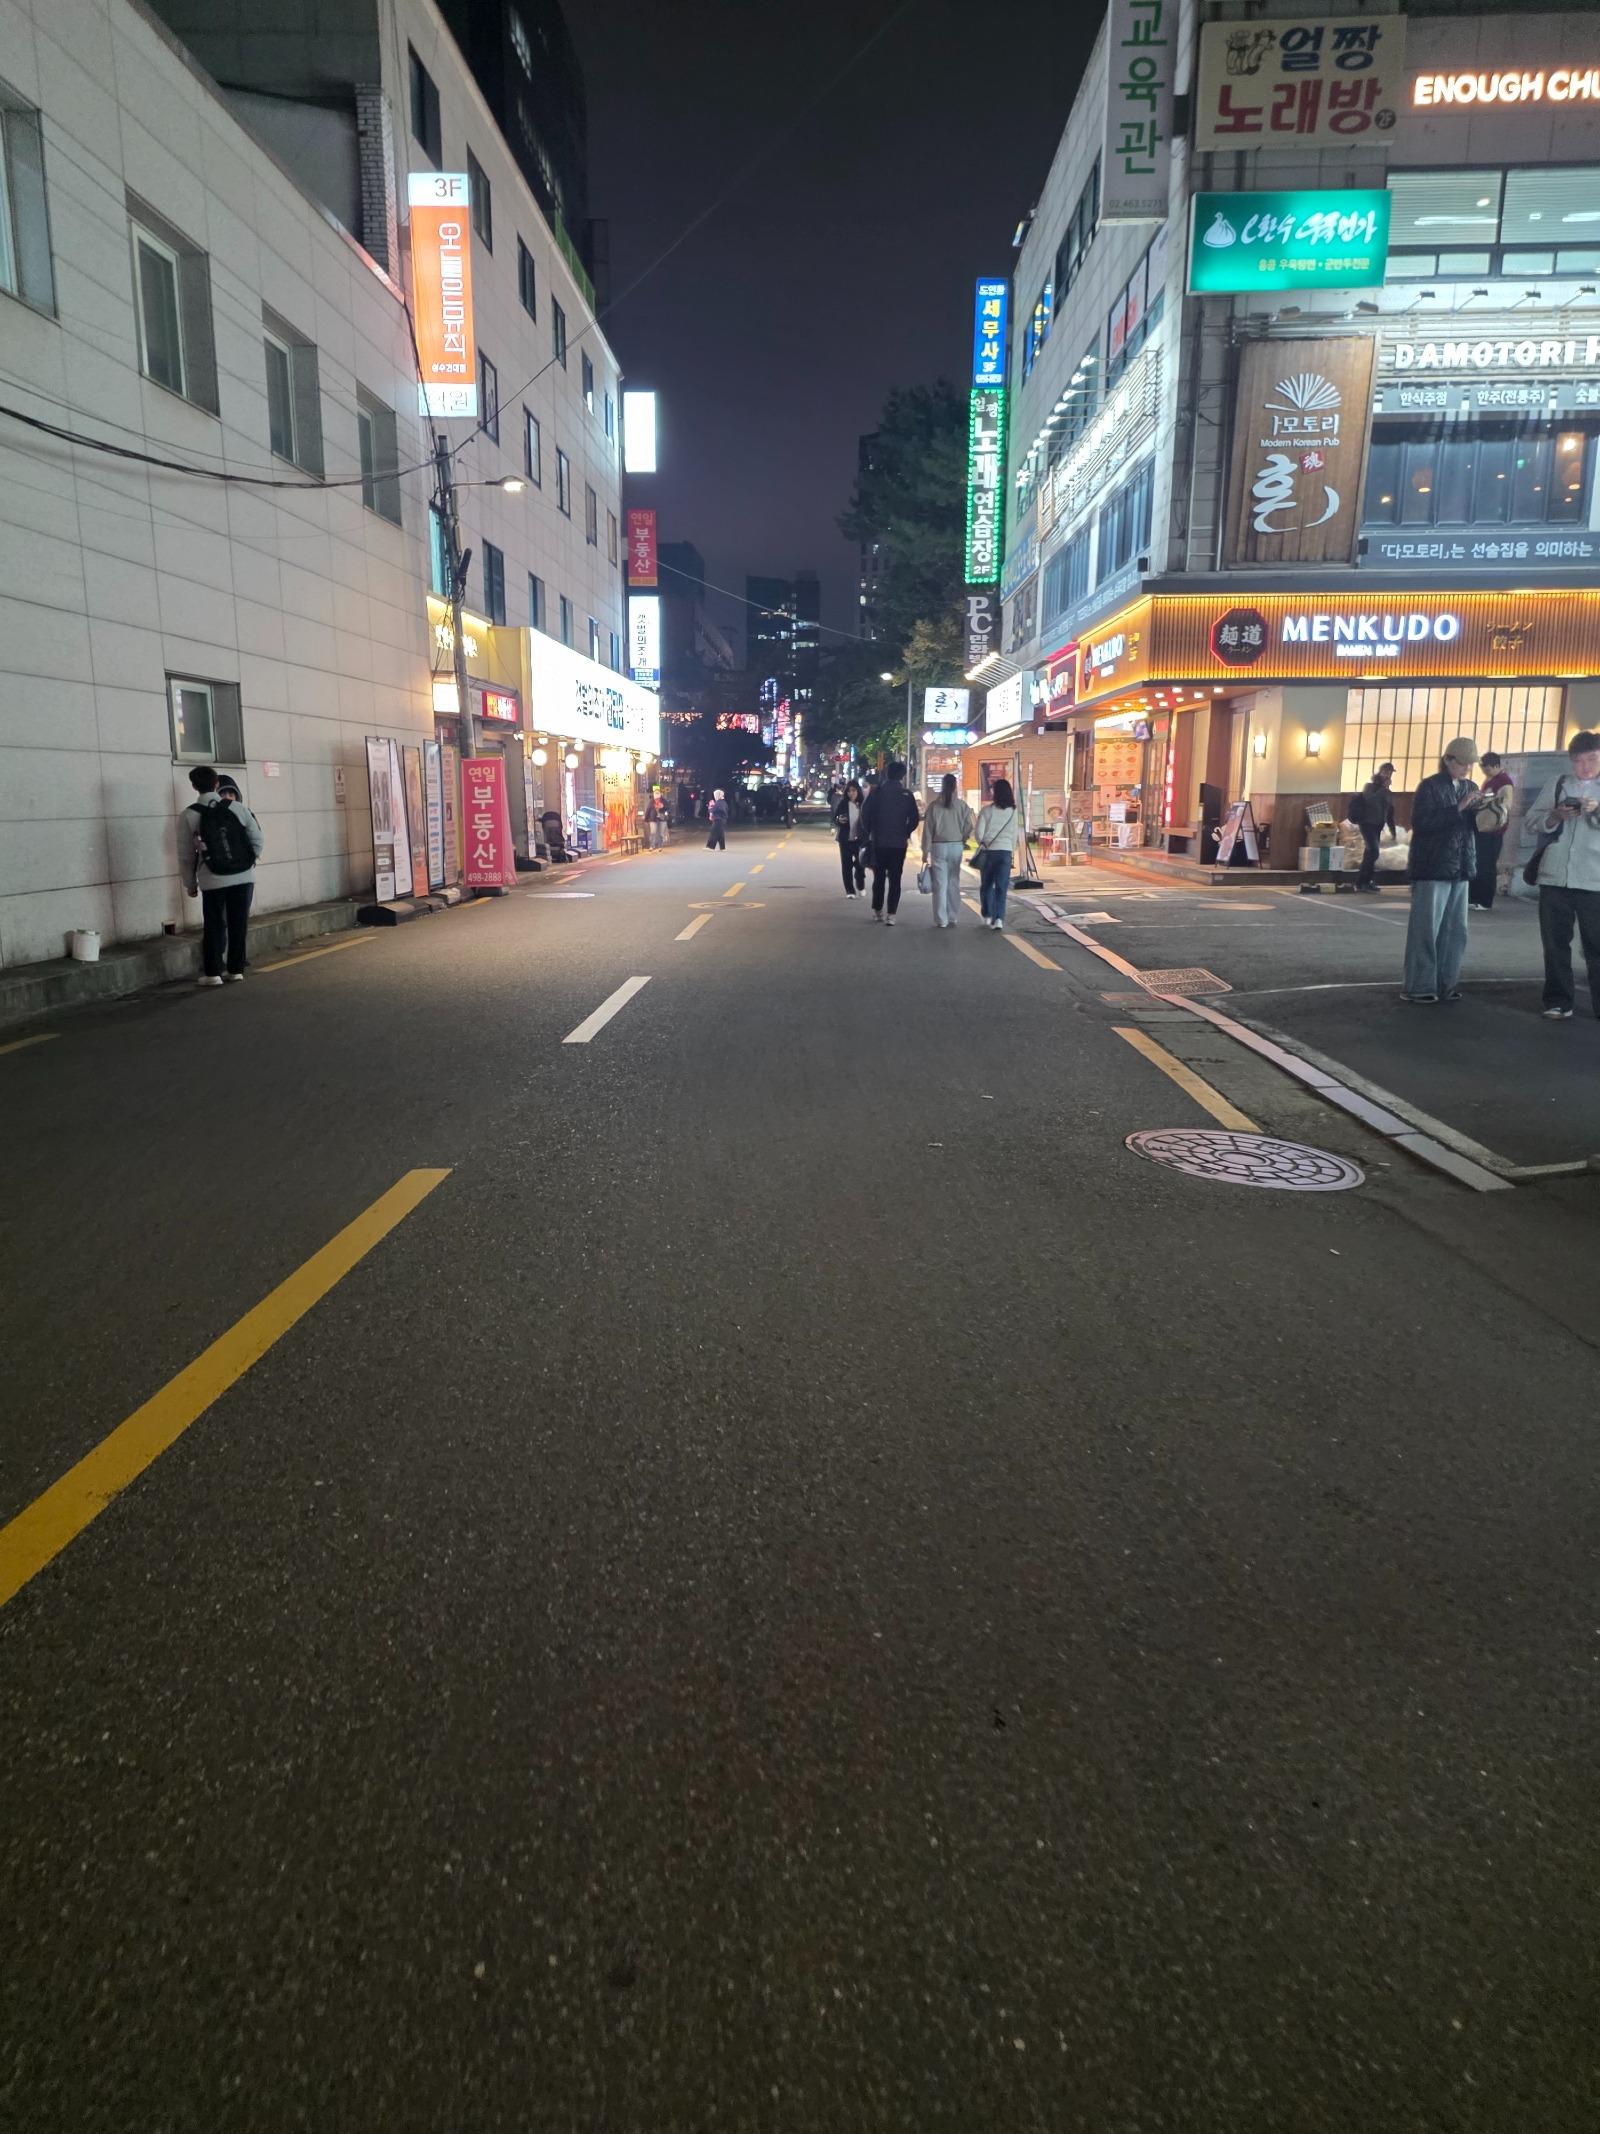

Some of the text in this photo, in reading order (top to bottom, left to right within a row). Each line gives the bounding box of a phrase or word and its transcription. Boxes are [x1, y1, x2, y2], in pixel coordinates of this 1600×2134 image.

[1279, 25, 1382, 72] 얼짱
[1115, 1, 1168, 175] 교육관
[1414, 72, 1544, 105] ENOUGH
[1213, 77, 1393, 135] 노래방 2F
[434, 178, 462, 198] 3F
[981, 298, 1001, 360] 세무사
[1395, 340, 1577, 369] DAMOTORI
[1400, 391, 1448, 407] 한식주점
[1260, 437, 1340, 448] Modern Korean Pub
[634, 528, 651, 574] 부동산
[1470, 541, 1529, 559] 선술집을
[1534, 540, 1594, 558] 의미하는
[1282, 614, 1459, 642] MENKUDO
[468, 766, 496, 782] 연일
[471, 785, 497, 869] 부동산
